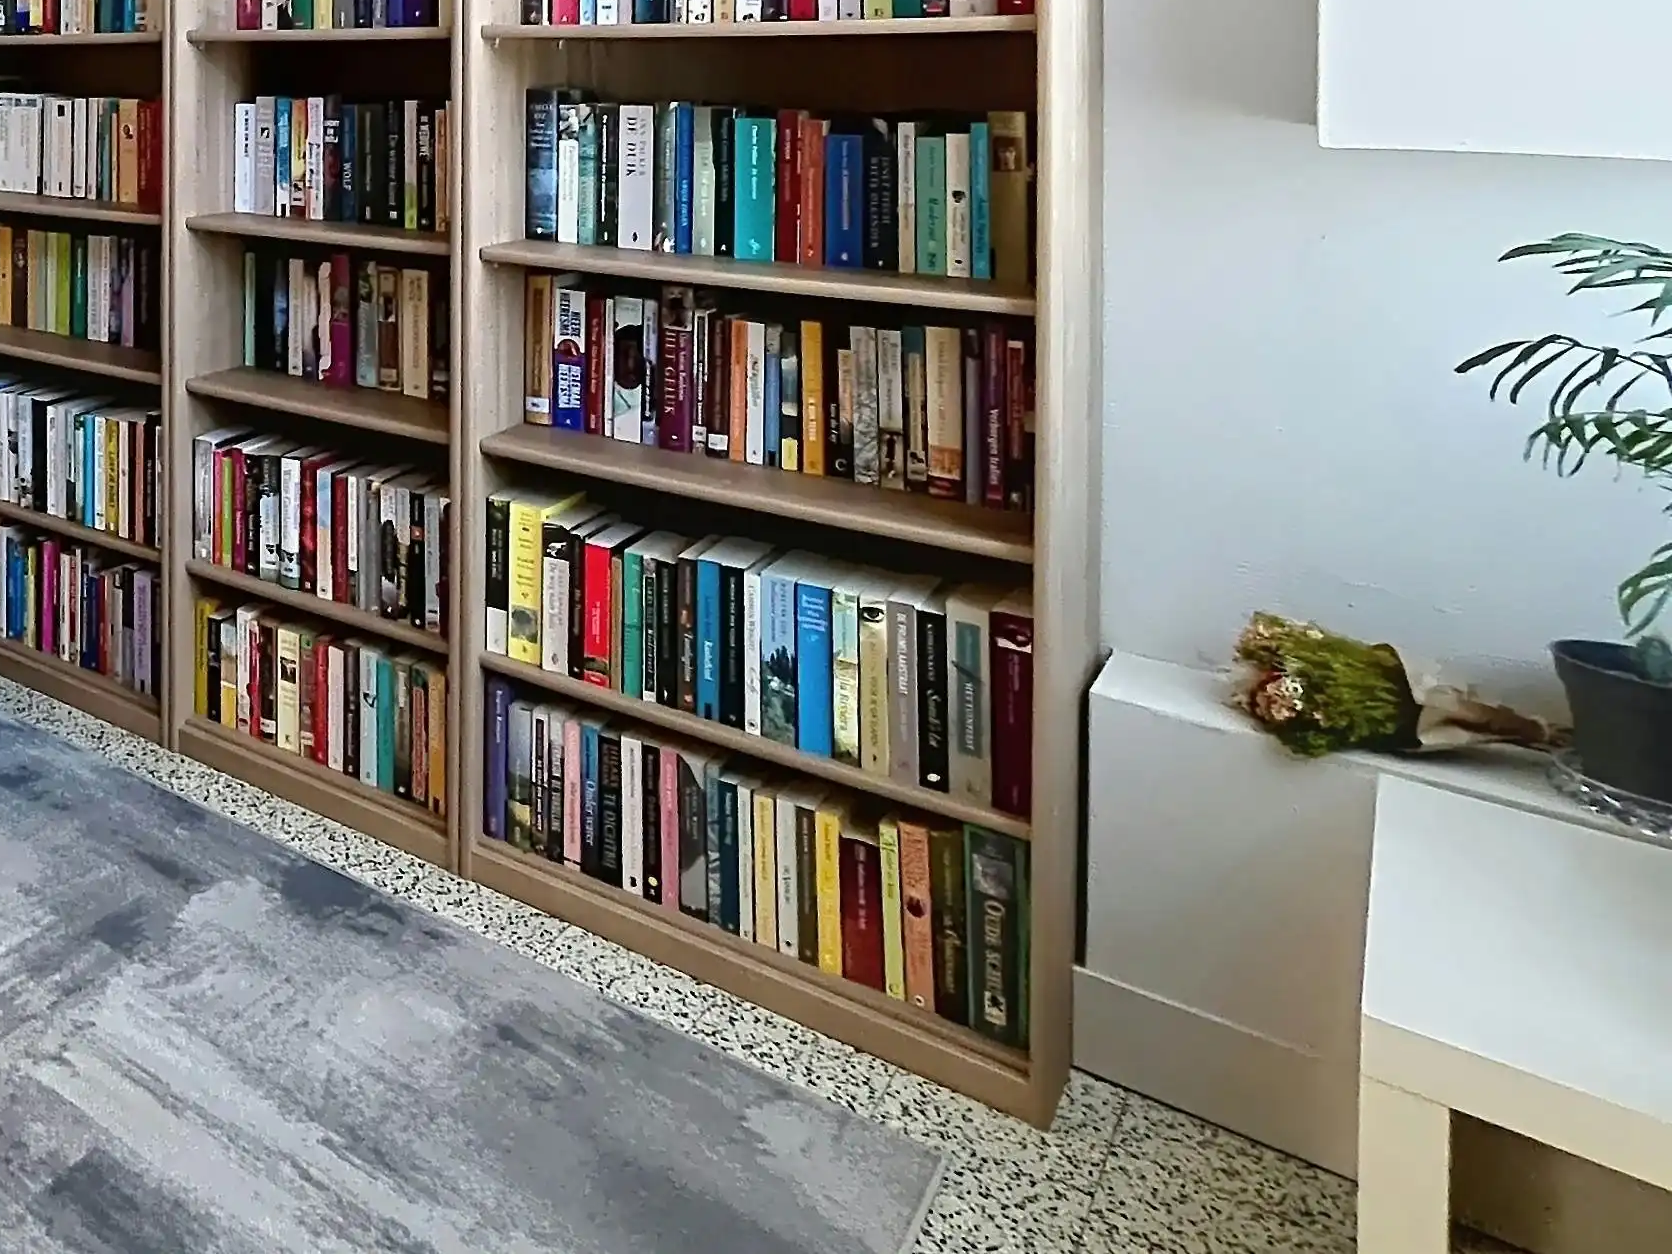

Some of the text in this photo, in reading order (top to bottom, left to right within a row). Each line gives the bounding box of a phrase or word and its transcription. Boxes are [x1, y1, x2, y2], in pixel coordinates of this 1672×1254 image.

[343, 161, 352, 191] WOLF
[559, 292, 570, 337] HEERESMA
[572, 311, 581, 338] HEERE
[558, 363, 570, 408] HEERESMA
[570, 365, 581, 408] HELEMAAL
[987, 409, 1000, 454] Verborgen
[586, 780, 597, 814] Onder
[984, 900, 1006, 945] OUDE
